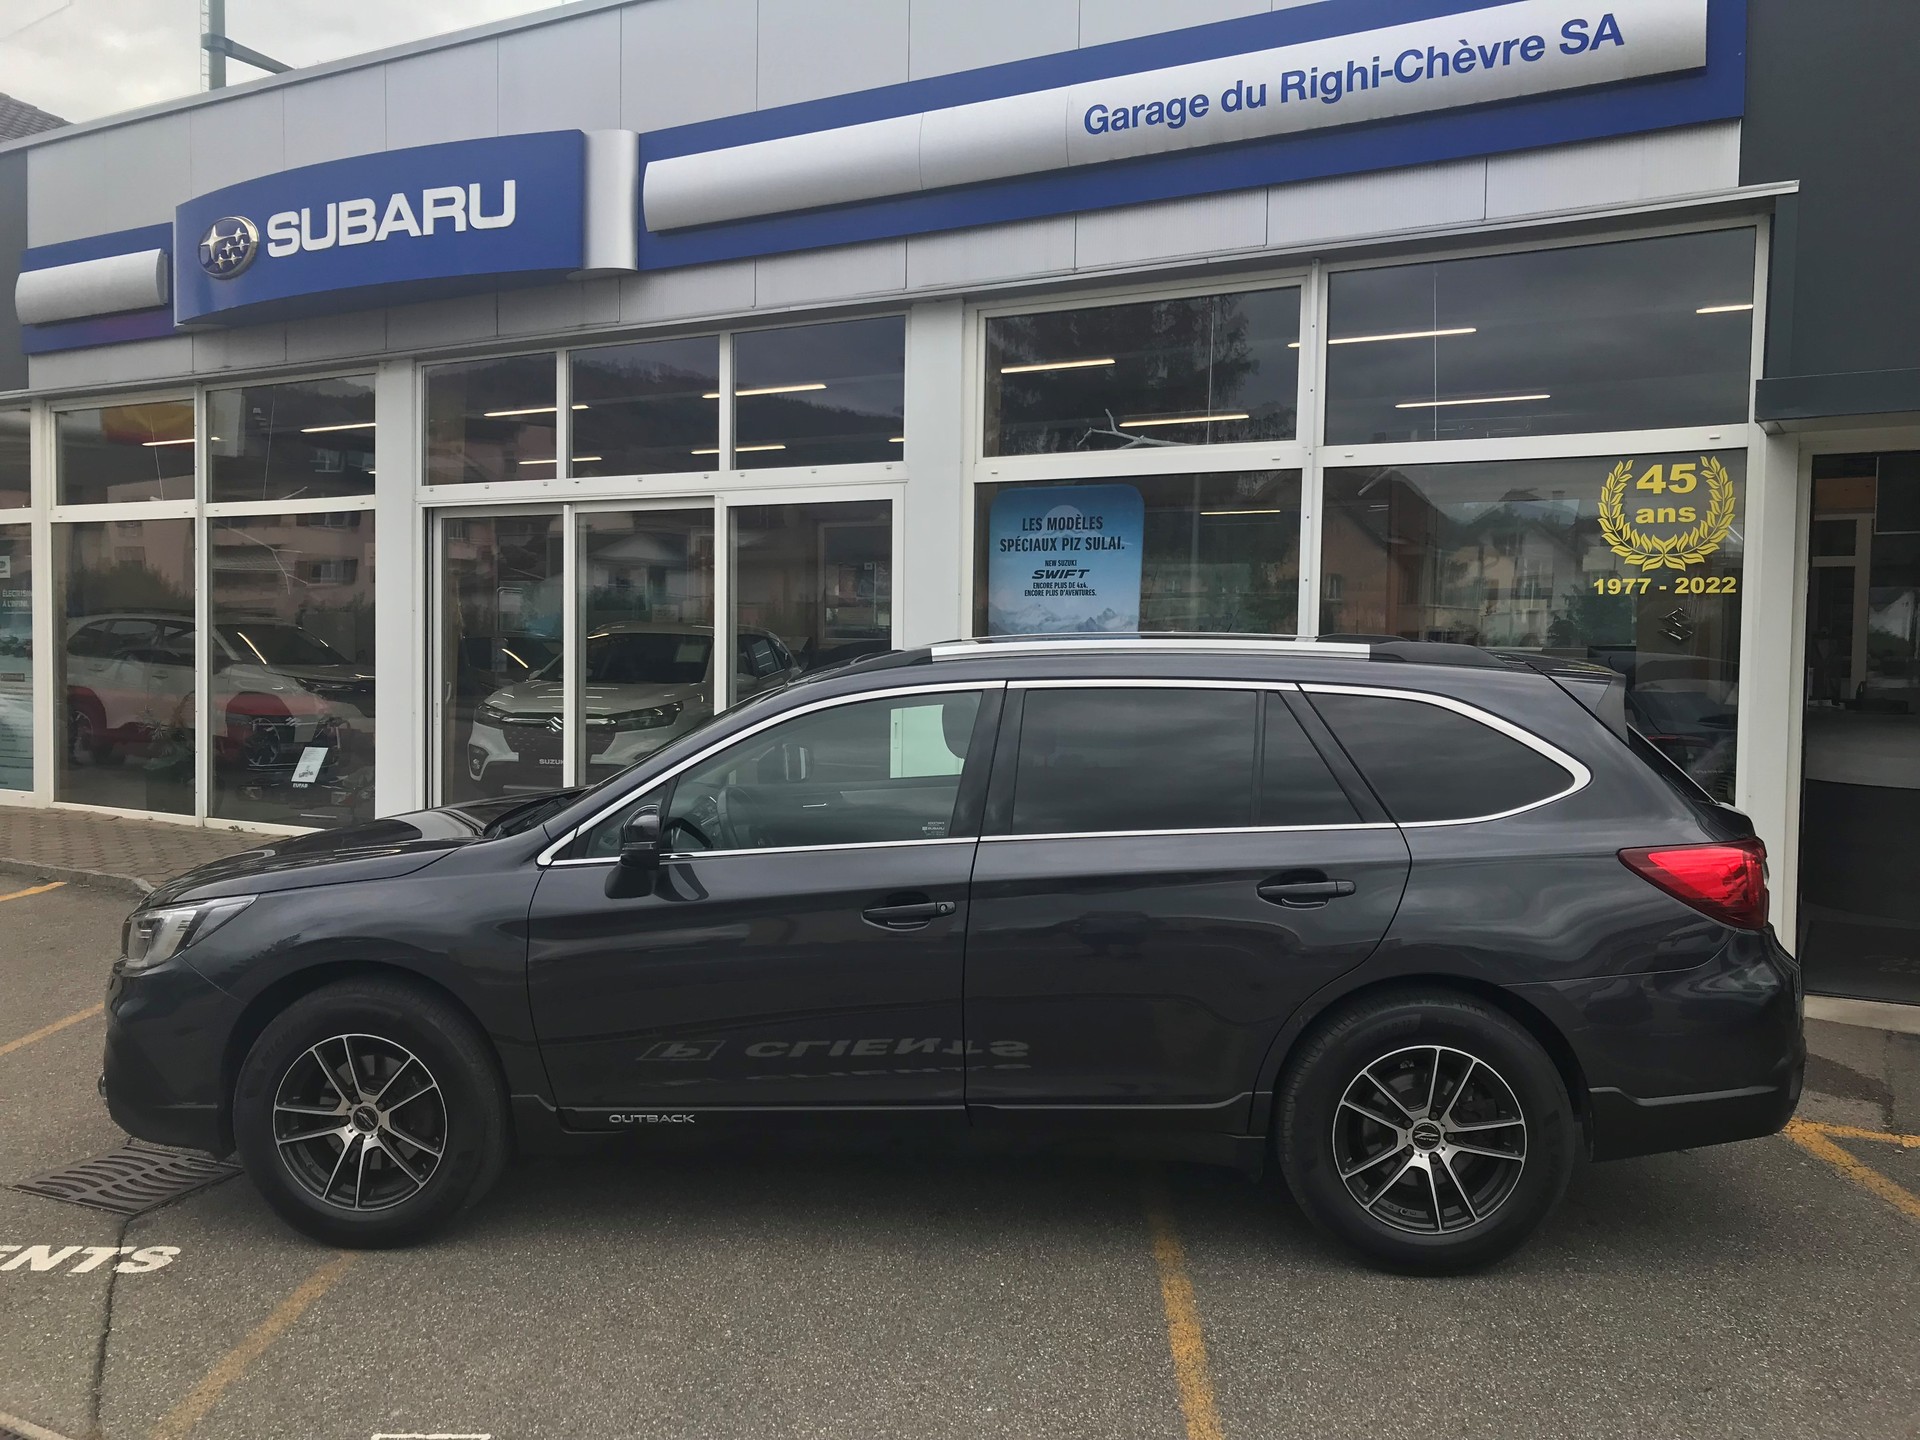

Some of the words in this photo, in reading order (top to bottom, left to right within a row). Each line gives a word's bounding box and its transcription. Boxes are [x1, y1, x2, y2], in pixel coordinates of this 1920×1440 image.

[1083, 90, 1210, 136] Garage
[1221, 79, 1268, 113] du
[1280, 31, 1546, 105] Righi-Chèvre
[1559, 13, 1626, 56] SA
[266, 179, 516, 258] SUBARU
[1636, 463, 1698, 494] 45
[1022, 517, 1042, 532] LES
[1047, 514, 1104, 531] MODÈLES
[1635, 506, 1697, 524] ans
[1000, 536, 1058, 552] SPÉCIAUX
[1061, 537, 1081, 551] PIZ
[1085, 536, 1125, 550] SULAI.
[1031, 569, 1091, 579] SWIFT
[1593, 577, 1652, 595] 1977
[1674, 576, 1737, 594] 2022
[608, 1114, 695, 1123] OUTBACK
